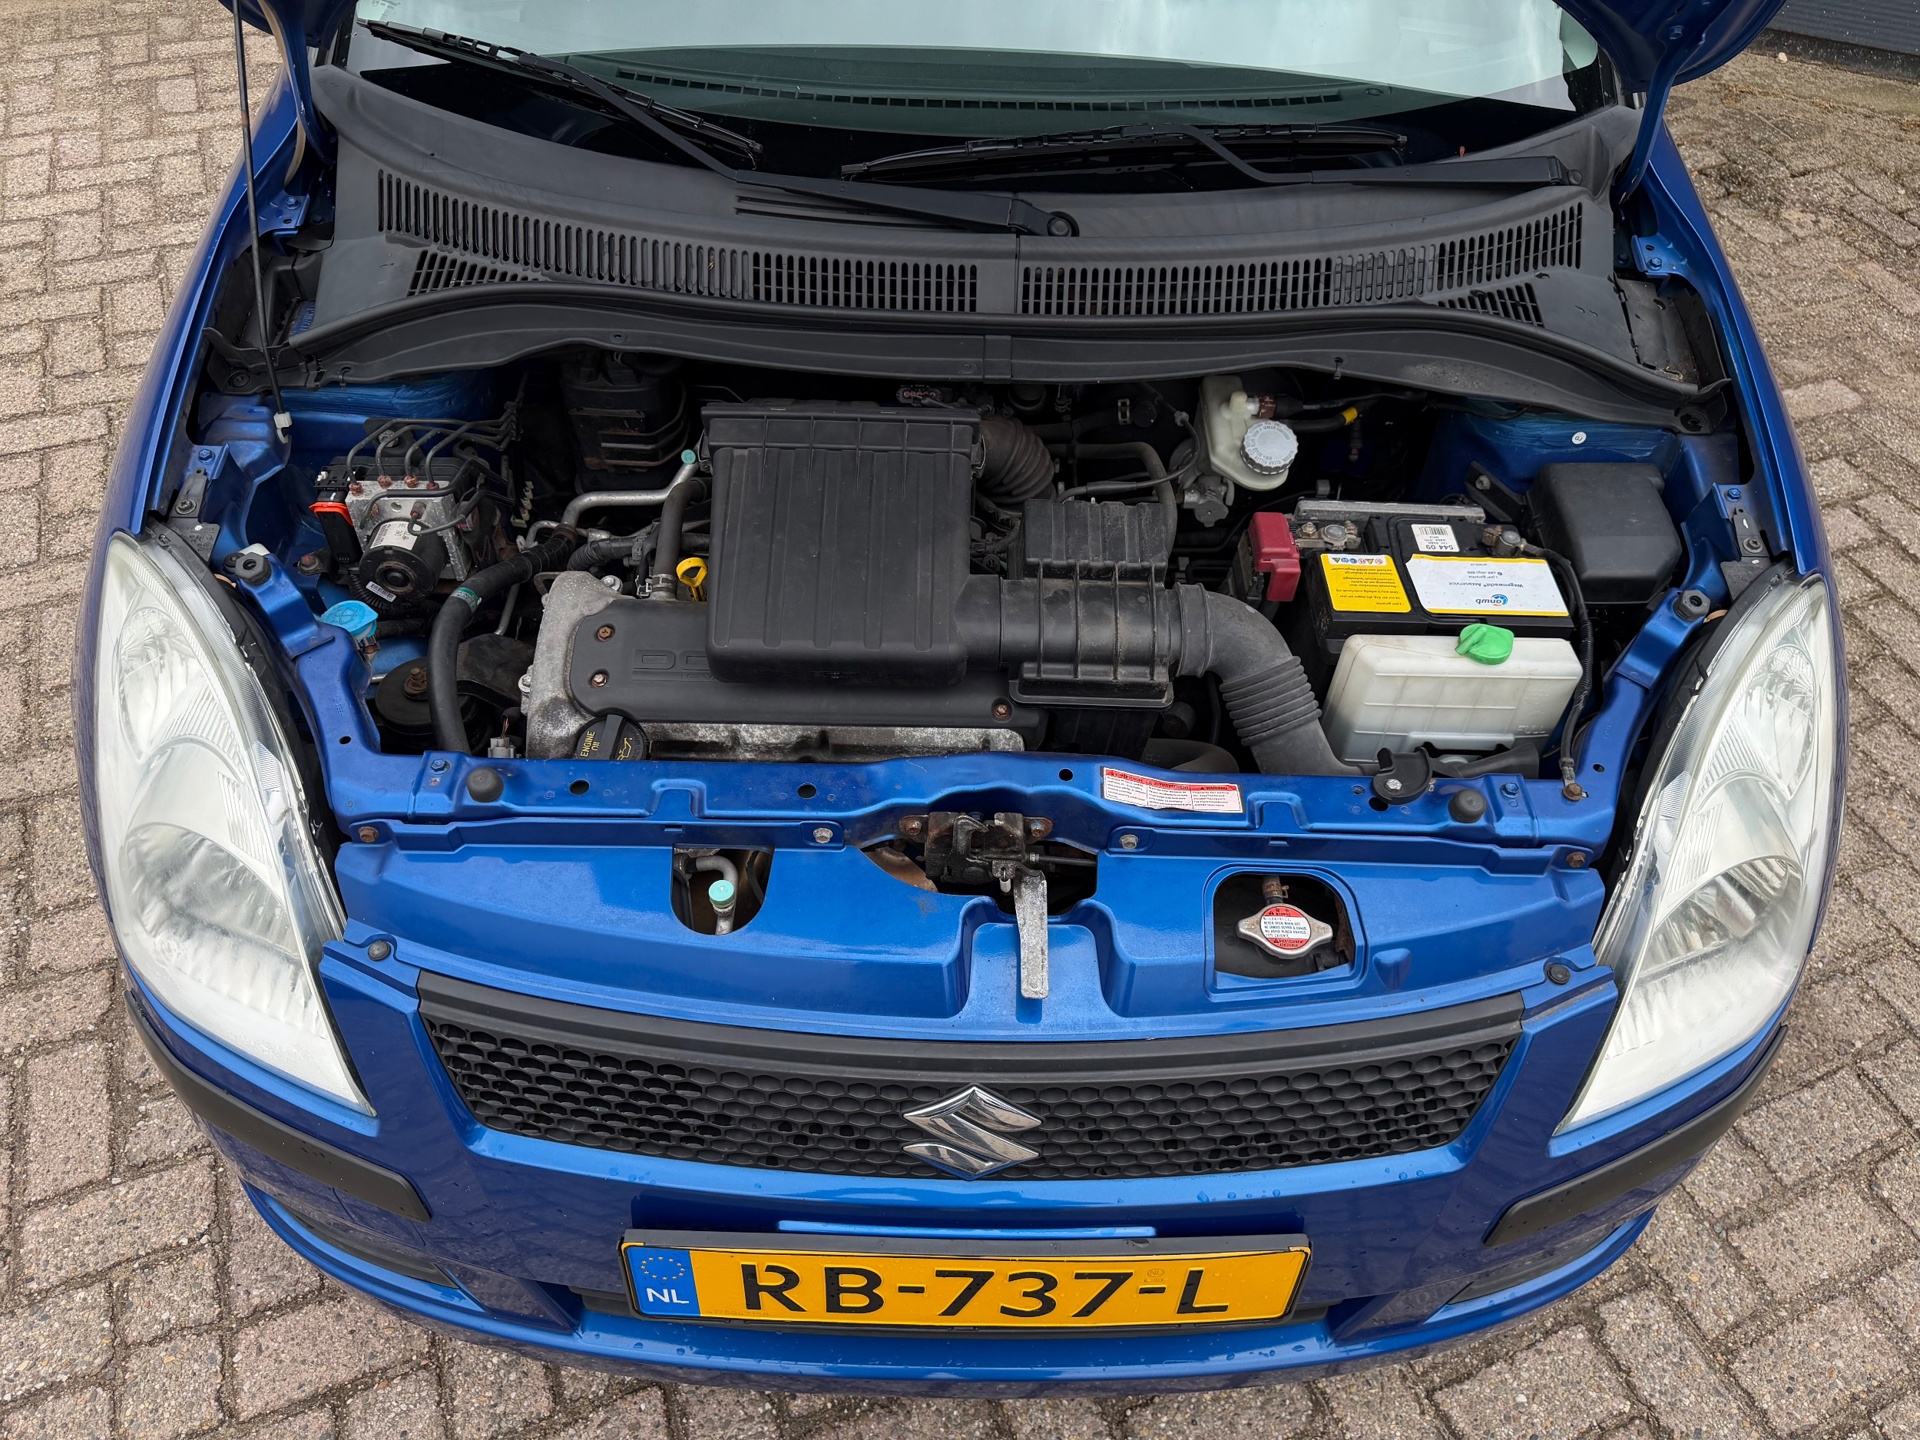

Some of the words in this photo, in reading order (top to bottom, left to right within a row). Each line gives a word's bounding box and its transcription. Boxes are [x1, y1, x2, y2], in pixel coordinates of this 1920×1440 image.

[633, 649, 709, 670] DO
[580, 731, 596, 757] ENGINE
[645, 1287, 690, 1305] NL
[742, 1263, 1229, 1318] RB-737-L
